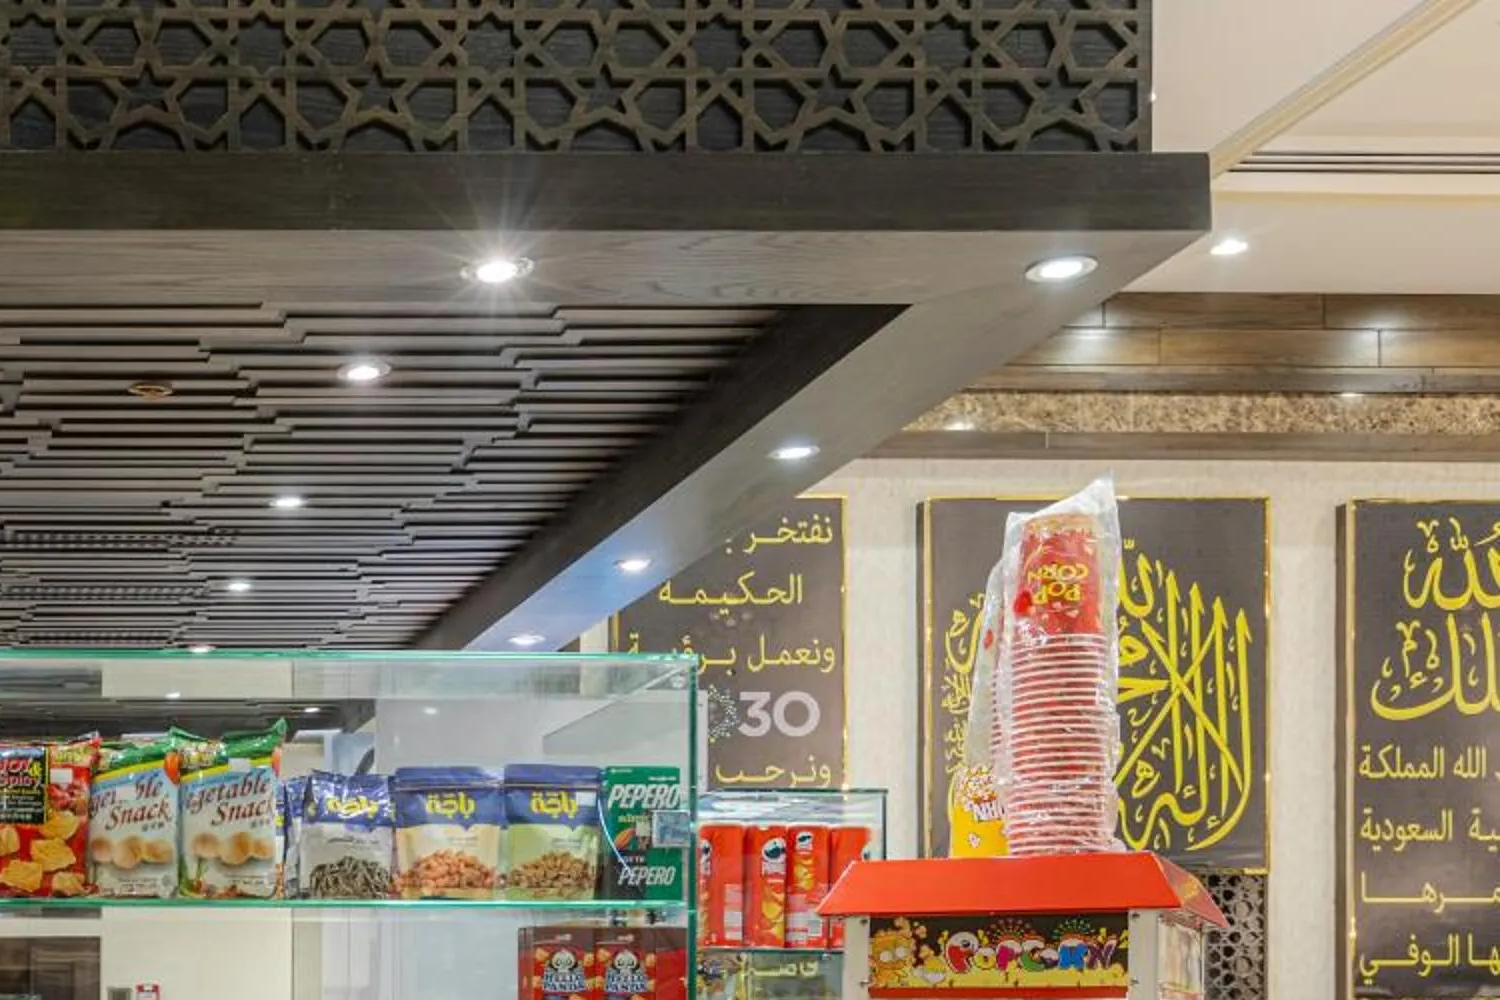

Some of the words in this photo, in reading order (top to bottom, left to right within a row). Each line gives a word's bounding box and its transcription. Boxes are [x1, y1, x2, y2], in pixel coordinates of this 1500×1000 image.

[742, 513, 833, 553] نفتخر
[627, 632, 737, 676] برؤة
[746, 633, 836, 673] ونعمل
[715, 754, 832, 788] ونرحب
[1358, 743, 1445, 779] المملكة
[1453, 744, 1487, 779] الله
[607, 783, 681, 809] PEPERO
[105, 800, 172, 831] Snack
[1360, 806, 1453, 852] السعودية
[617, 865, 676, 886] PEPERO
[1359, 933, 1460, 985] الوفي
